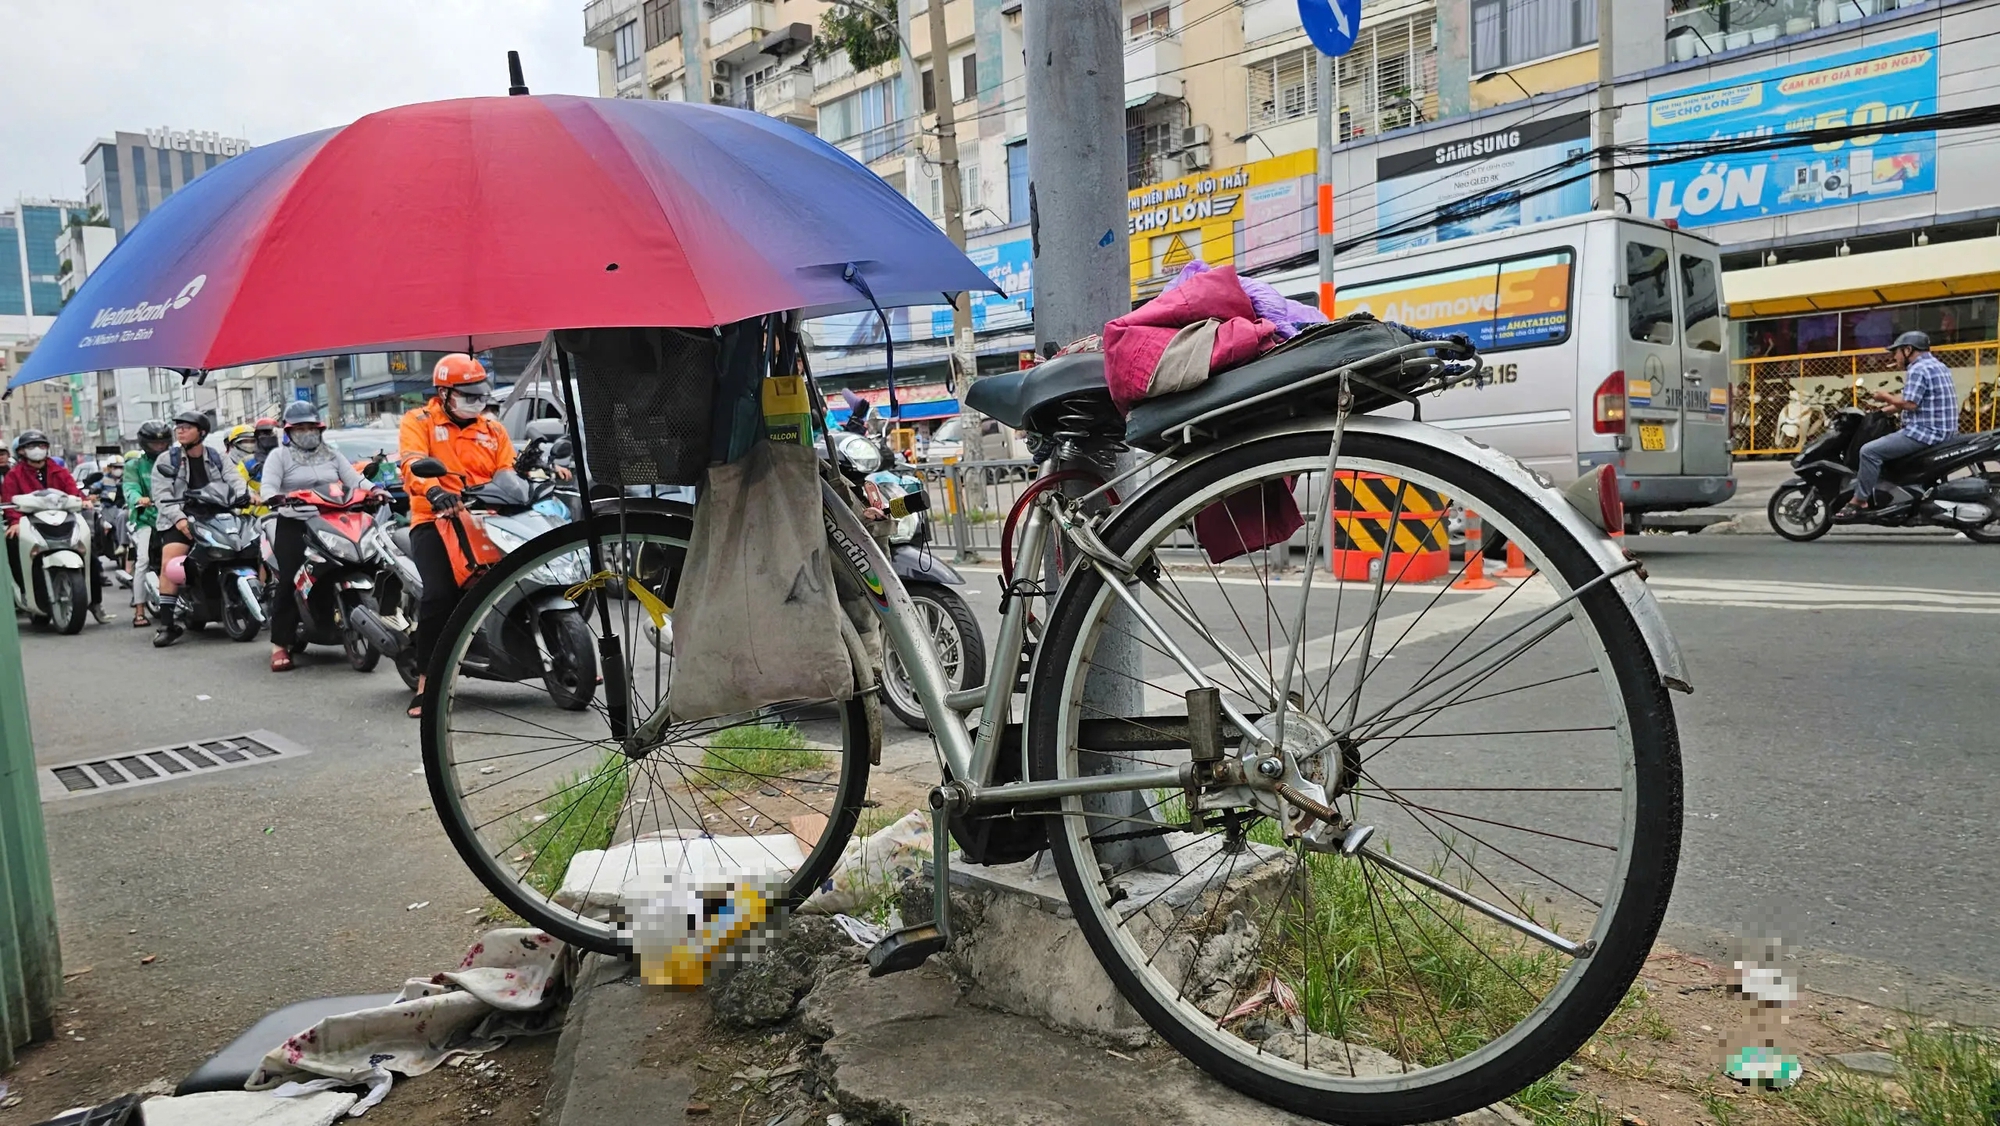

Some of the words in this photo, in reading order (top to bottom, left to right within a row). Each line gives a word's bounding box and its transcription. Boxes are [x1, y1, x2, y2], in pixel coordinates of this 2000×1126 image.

[1874, 61, 1888, 72] 30
[1435, 130, 1521, 164] SAMSUNG
[1220, 167, 1250, 190] THẤT
[1654, 161, 1768, 221] LỚN
[1135, 207, 1171, 232] CHỢ
[1172, 199, 1215, 224] LỚN
[1383, 291, 1501, 324] Ahamove
[769, 431, 798, 441] FALCON
